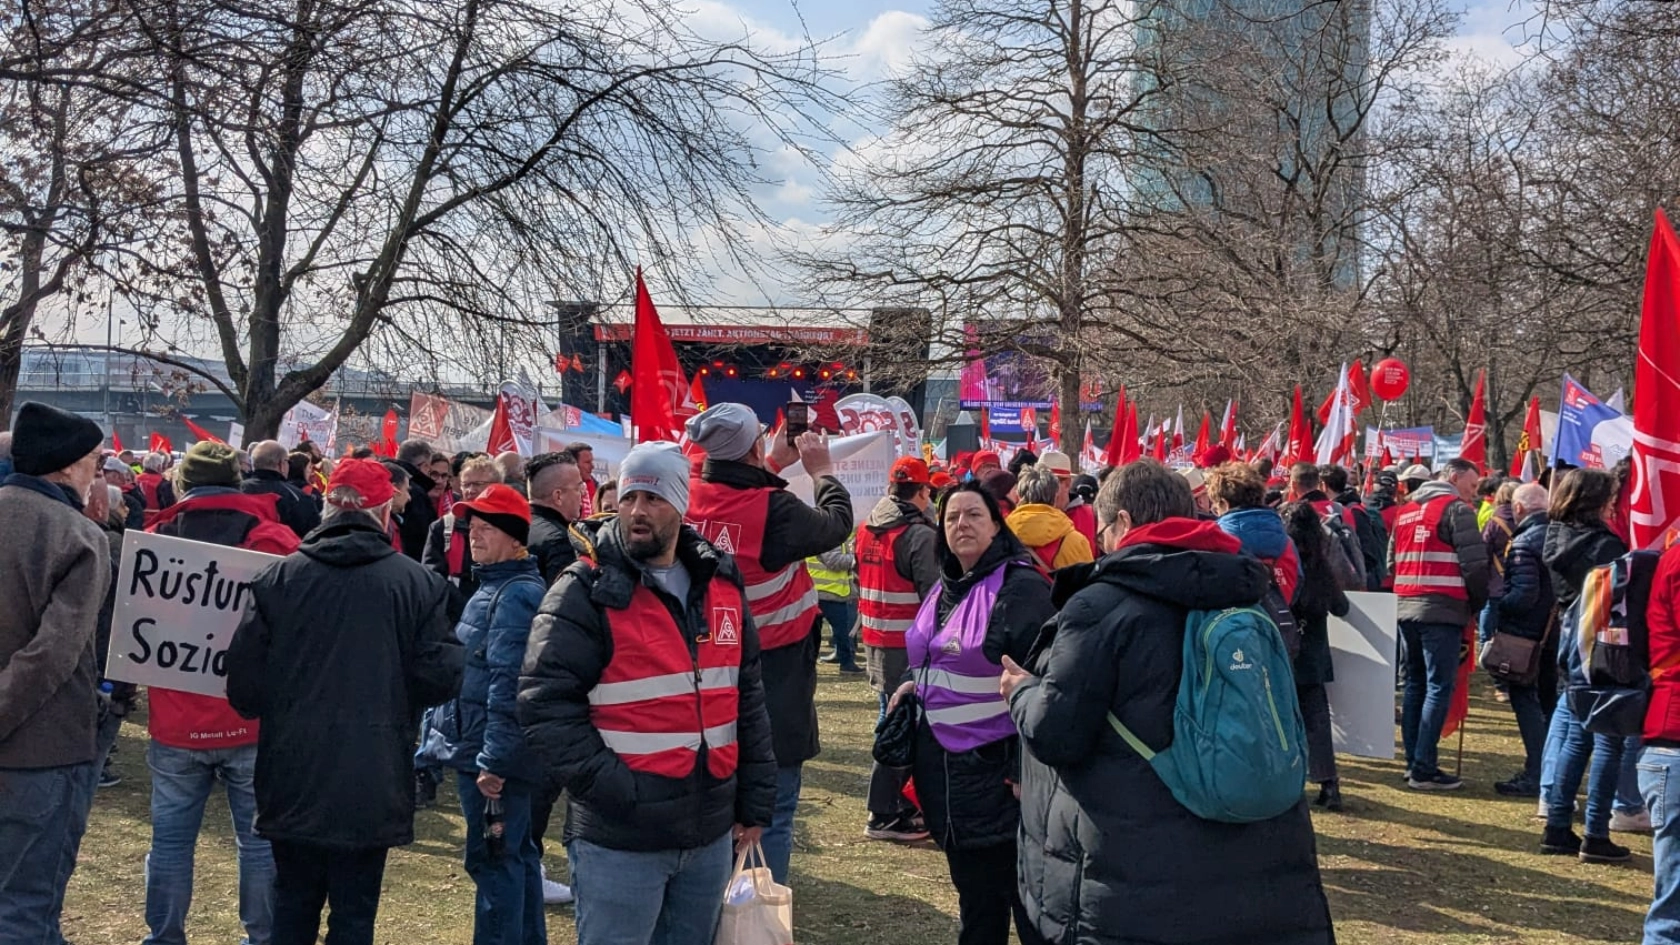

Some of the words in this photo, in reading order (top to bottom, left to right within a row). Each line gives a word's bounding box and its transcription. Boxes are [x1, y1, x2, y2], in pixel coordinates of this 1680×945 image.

[671, 328, 694, 337] JETZT
[1230, 663, 1253, 671] deuter
[201, 731, 223, 739] Metall
